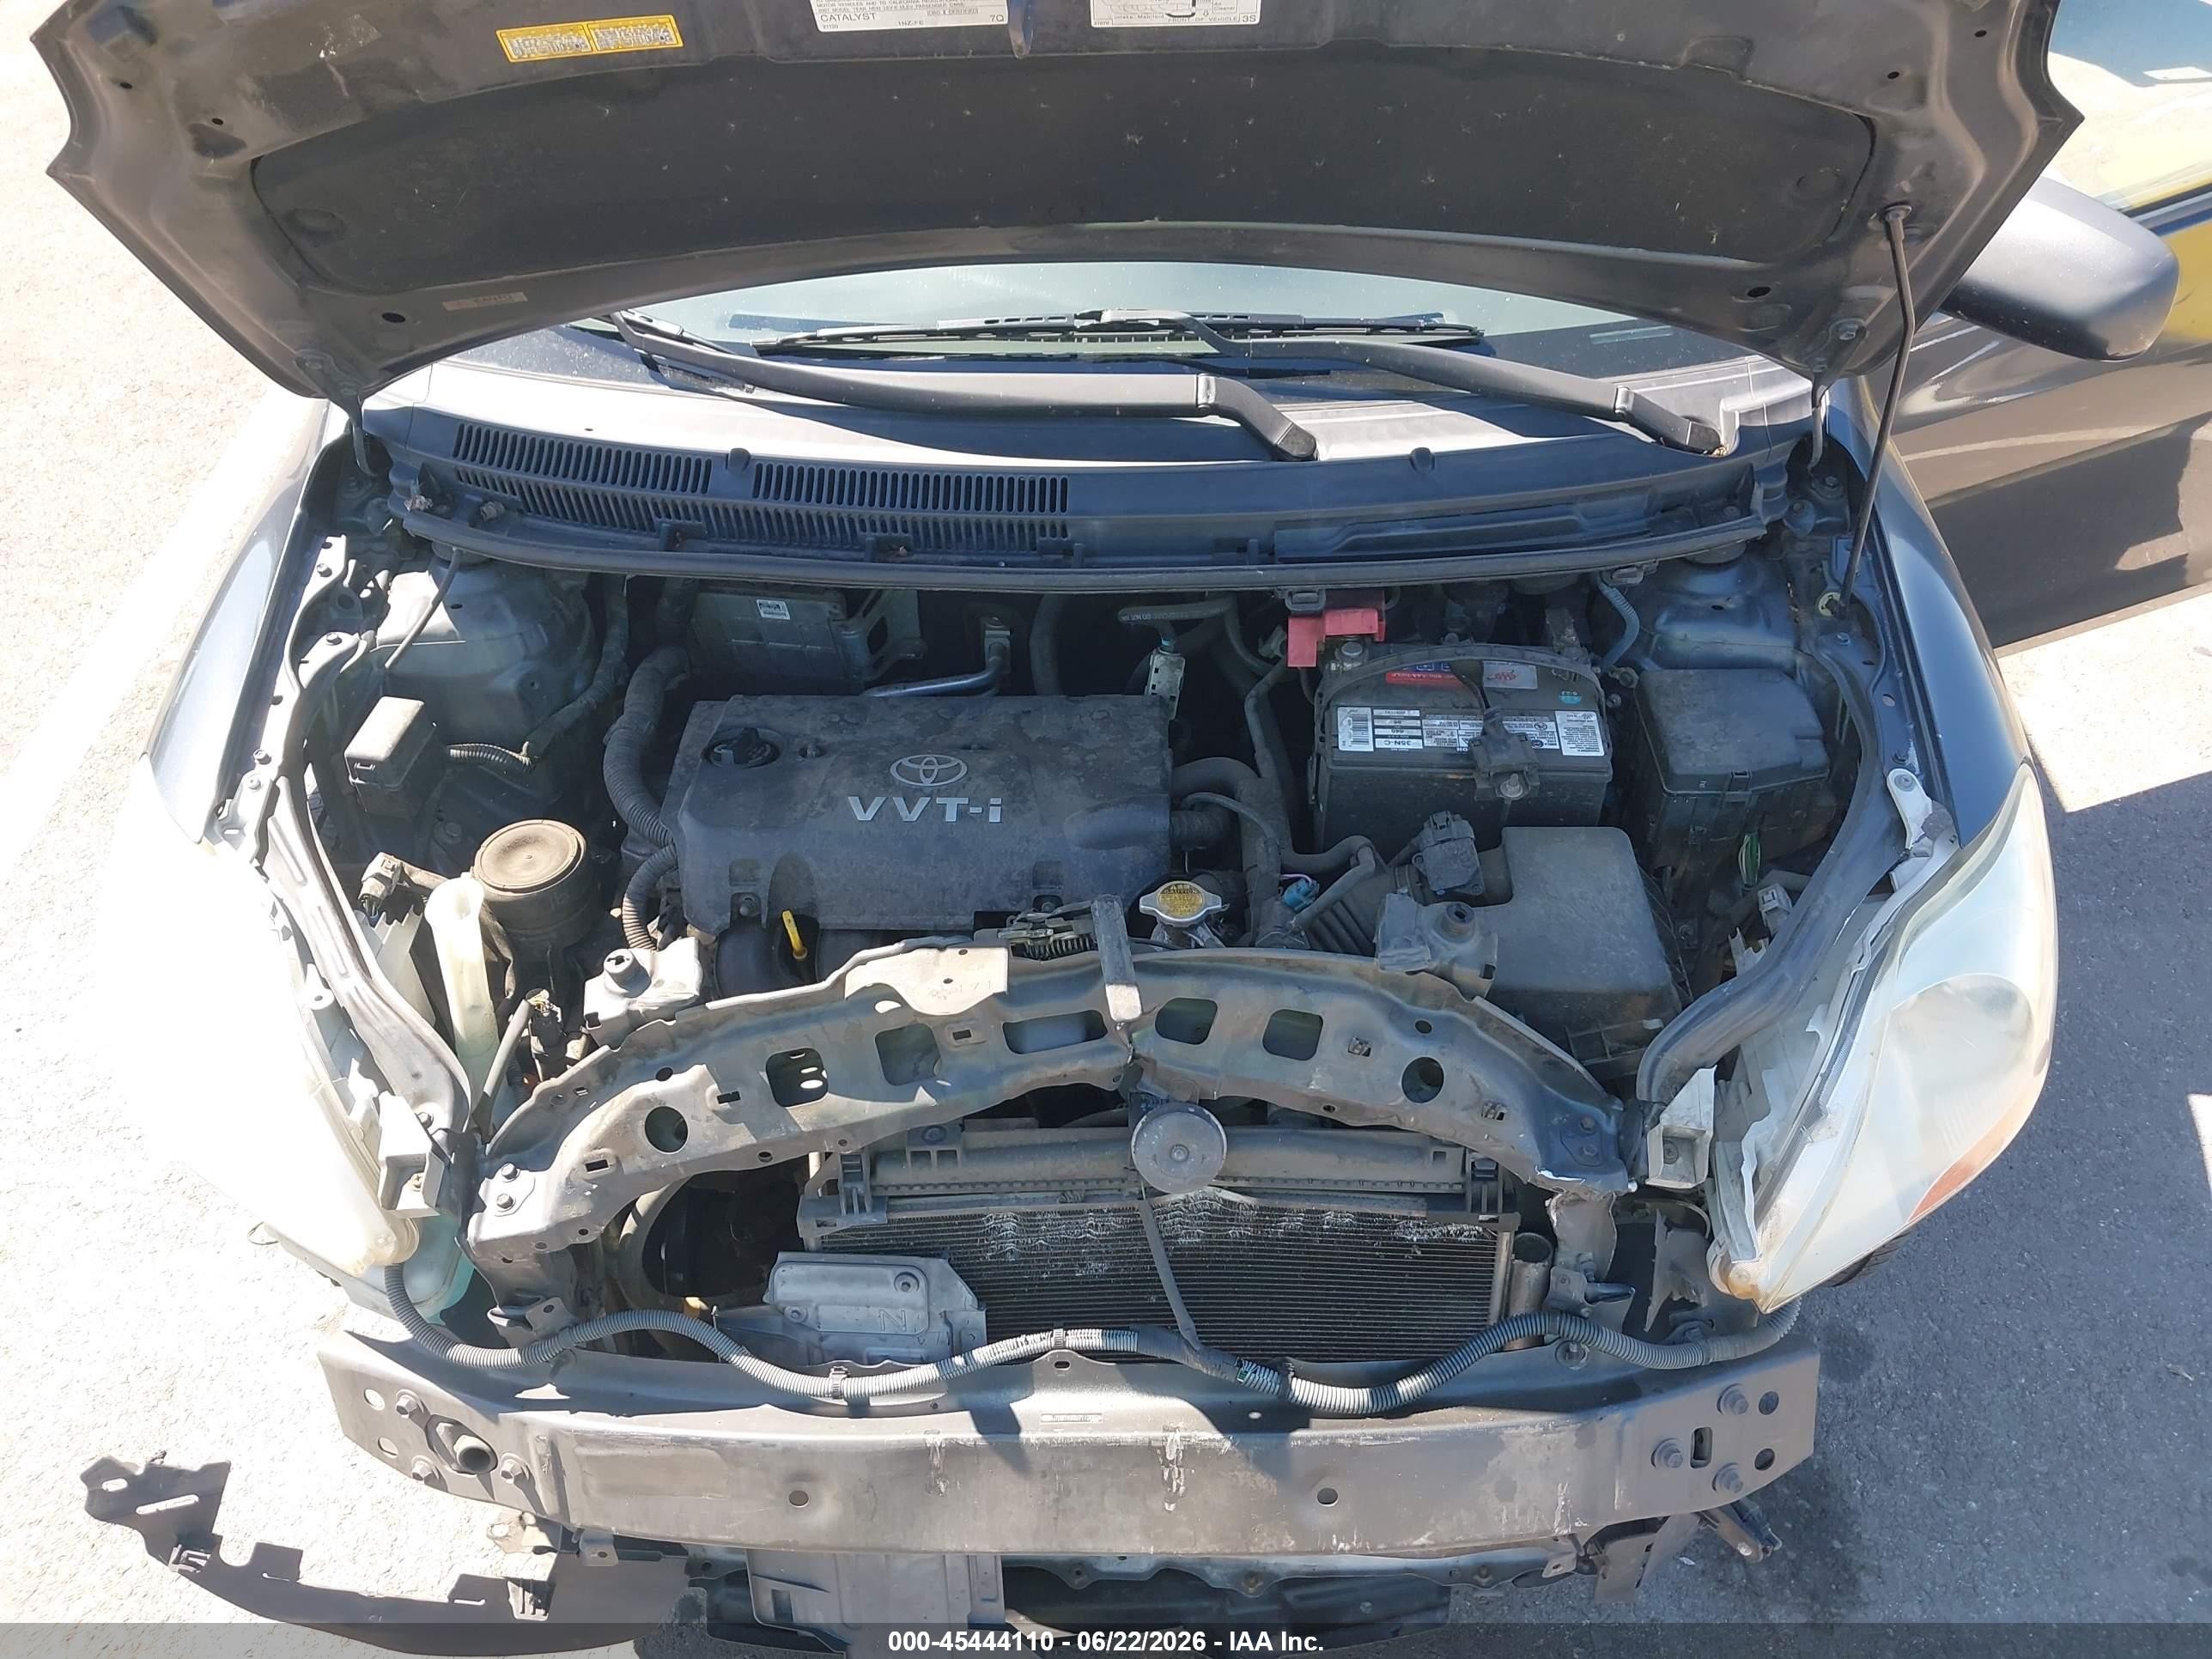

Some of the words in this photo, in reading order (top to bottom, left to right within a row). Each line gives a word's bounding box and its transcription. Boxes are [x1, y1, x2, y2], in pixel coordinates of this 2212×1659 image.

[820, 13, 876, 21] CATALYST
[989, 14, 1005, 23] 7Q
[847, 795, 1003, 823] VVT-i
